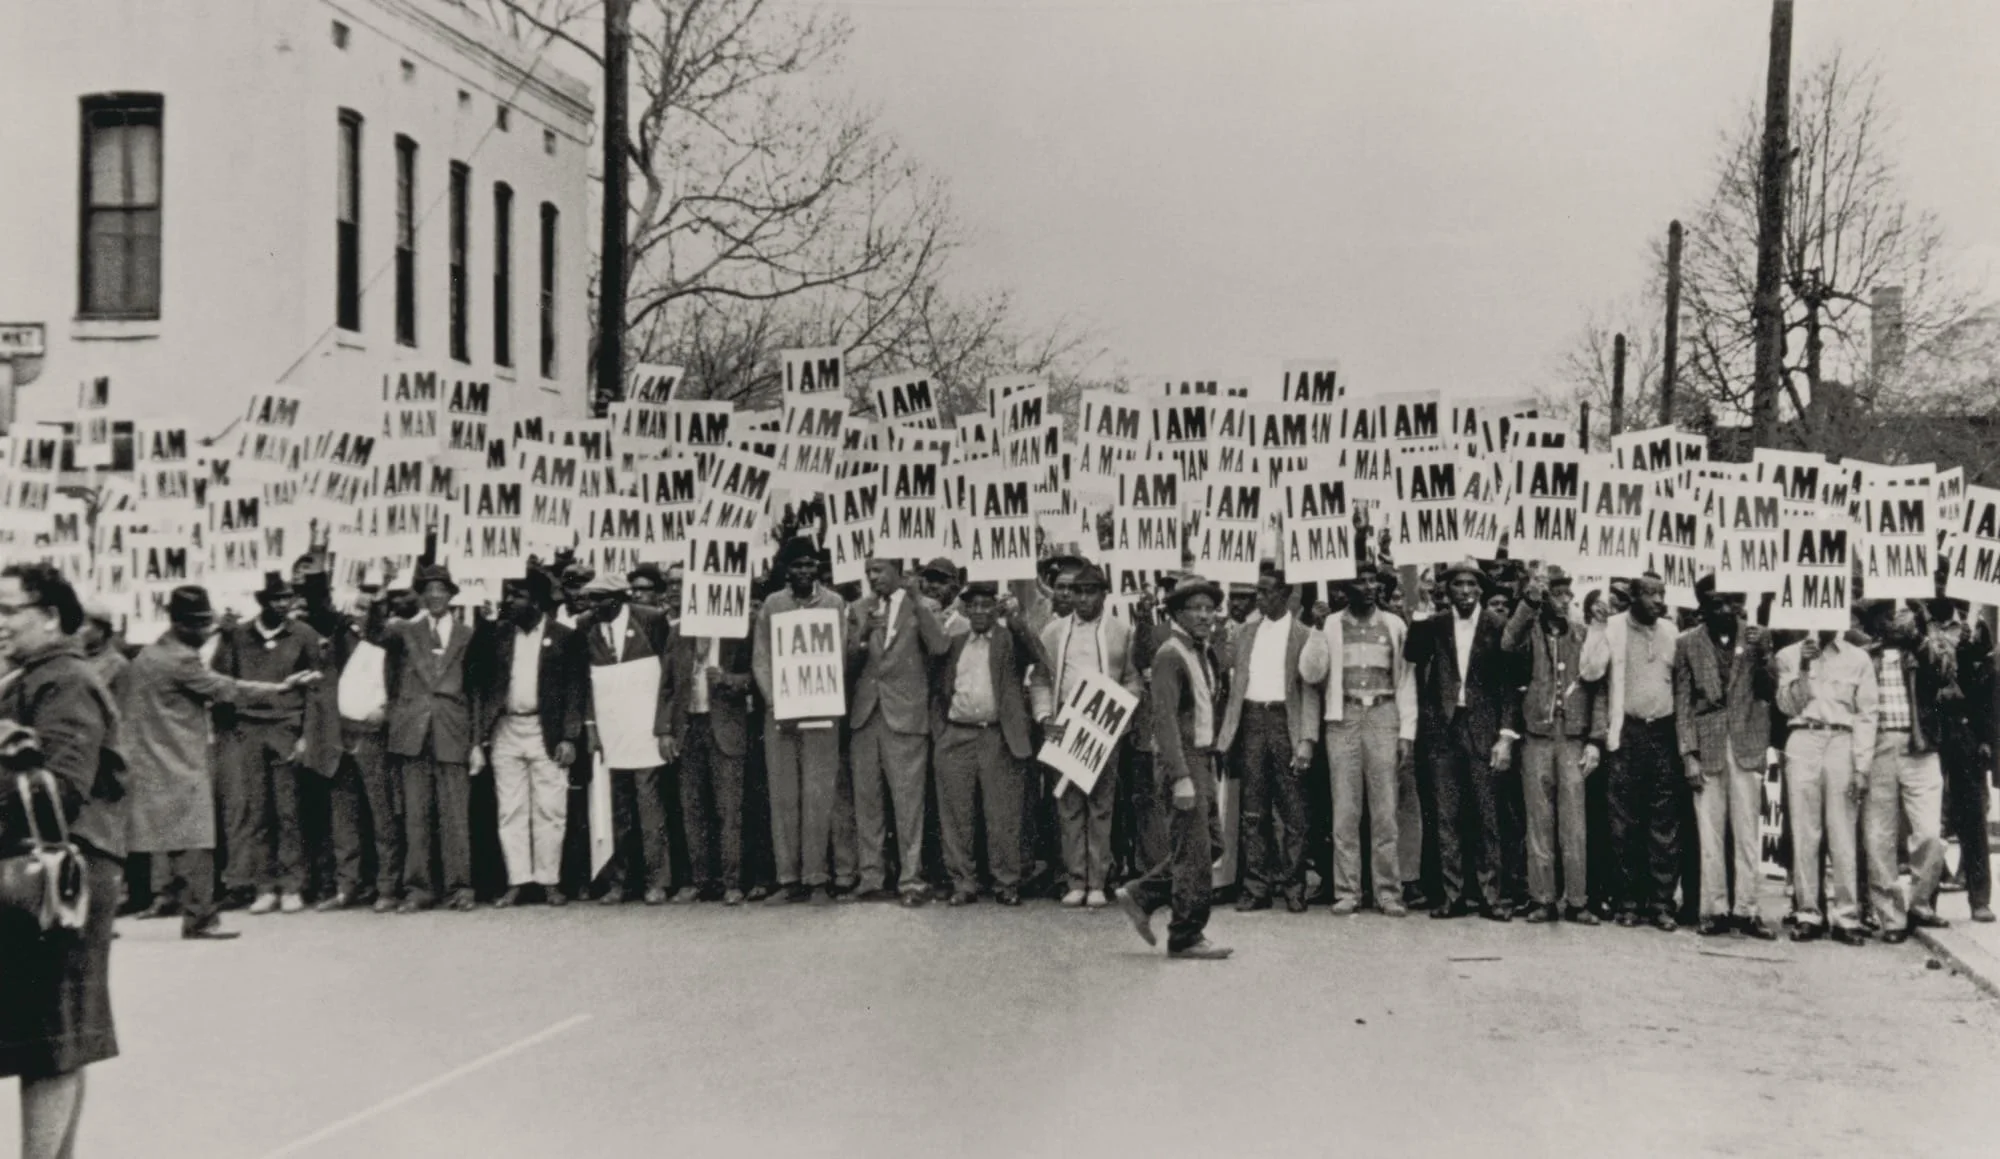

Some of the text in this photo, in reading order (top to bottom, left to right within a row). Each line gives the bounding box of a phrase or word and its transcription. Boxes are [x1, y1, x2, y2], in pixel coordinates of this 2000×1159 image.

[383, 371, 436, 401] I AM
[639, 376, 675, 403] AM
[787, 357, 839, 393] I AM
[1283, 371, 1336, 402] I AM
[257, 395, 300, 427] AM
[449, 380, 489, 413] AM
[878, 380, 932, 418] I AM
[382, 410, 436, 438] A MAN
[623, 408, 667, 439] A MAN
[675, 412, 729, 444] I AM
[785, 407, 795, 434] I
[798, 407, 843, 437] AM
[1009, 397, 1042, 432] AM
[1084, 402, 1140, 439] I AM
[1152, 406, 1207, 441] I AM
[1249, 413, 1307, 447] I AM
[1340, 408, 1347, 438] I
[1380, 402, 1437, 438] I AM
[1453, 408, 1458, 435] I
[152, 428, 186, 459] AM
[330, 432, 375, 466] AM
[449, 420, 486, 451] MAN
[1011, 436, 1040, 467] MAN
[22, 438, 56, 470] AM
[778, 444, 789, 471] A
[794, 445, 835, 474] MAN
[1080, 443, 1090, 472] A
[1632, 438, 1671, 471] AM
[157, 470, 188, 498] MAN
[372, 461, 422, 496] I AM
[531, 455, 576, 487] AM
[642, 469, 694, 503] I AM
[712, 459, 770, 500] I AM
[882, 464, 888, 496] I
[896, 464, 936, 496] AM
[1396, 463, 1456, 500] I AM
[1516, 460, 1578, 497] I AM
[1773, 465, 1818, 500] AM
[464, 483, 521, 515] I AM
[970, 484, 976, 517] I
[985, 482, 1028, 516] AM
[1120, 473, 1177, 506] I AM
[1217, 486, 1260, 518] AM
[1286, 481, 1346, 519] I AM
[1582, 481, 1643, 516] I AM
[1937, 477, 1960, 500] AM
[209, 498, 259, 531] I AM
[386, 504, 420, 534] MAN
[531, 495, 572, 526] MAN
[589, 508, 640, 538] I AM
[700, 500, 713, 525] A
[716, 501, 757, 529] MAN
[829, 493, 837, 524] I
[880, 506, 936, 539] A MAN
[1514, 505, 1576, 541] A MAN
[1719, 496, 1779, 528] I AM
[1865, 499, 1872, 533] I
[1879, 500, 1924, 533] AM
[1962, 499, 1975, 533] I
[464, 526, 521, 557] A MAN
[645, 513, 654, 543] A
[1120, 517, 1177, 550] A MAN
[1400, 508, 1458, 544] A MAN
[1579, 524, 1640, 558] A MAN
[1646, 509, 1697, 549] I AM
[224, 540, 258, 568] MAN
[690, 539, 748, 573] I AM
[836, 534, 846, 563] A
[972, 528, 983, 560] A
[991, 526, 1030, 559] MAN
[1201, 528, 1257, 562] A MAN
[1290, 526, 1349, 562] A MAN
[1721, 540, 1732, 571] A
[1783, 529, 1847, 564] I AM
[132, 546, 137, 578] I
[145, 547, 187, 578] AM
[603, 547, 640, 573] MAN
[1664, 554, 1696, 588] MAN
[1868, 544, 1928, 577] A MAN
[1954, 544, 1967, 578] A
[687, 583, 746, 616] A MAN
[1781, 575, 1845, 609] A MAN
[777, 623, 835, 657] I AM
[780, 664, 838, 697] A MAN
[1071, 680, 1126, 736] I AM
[1068, 727, 1108, 773] MAN
